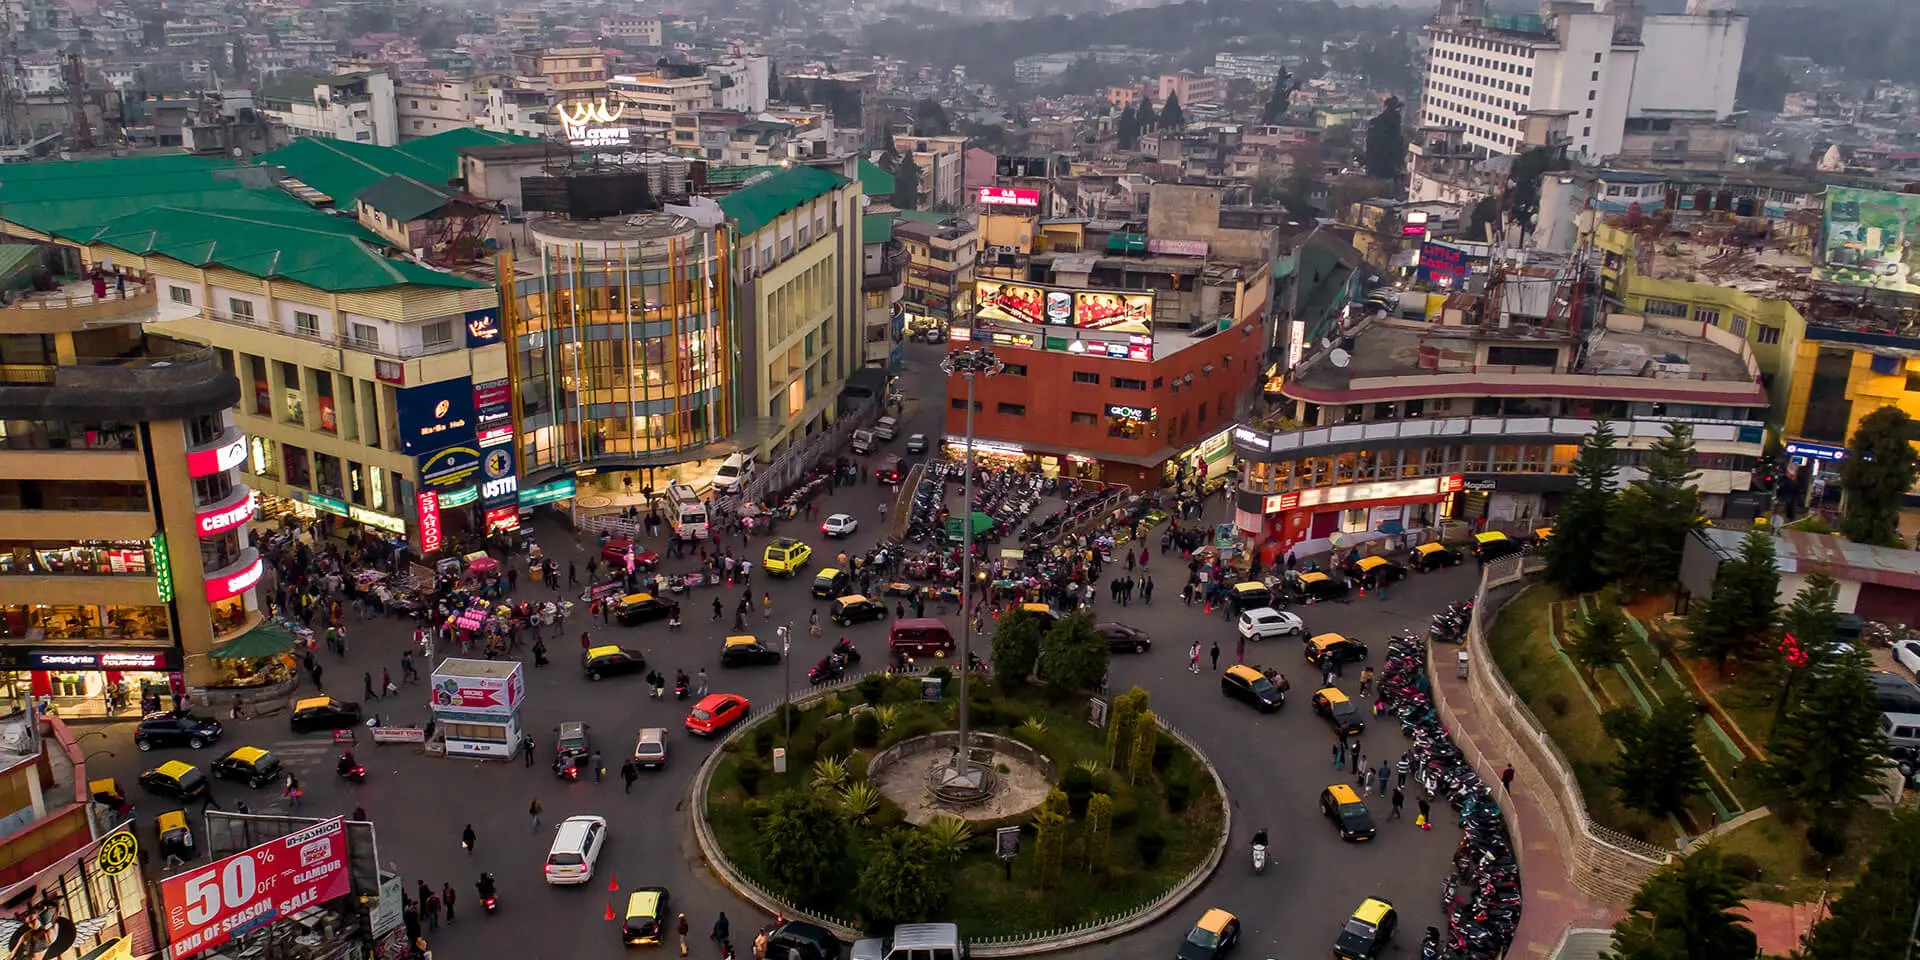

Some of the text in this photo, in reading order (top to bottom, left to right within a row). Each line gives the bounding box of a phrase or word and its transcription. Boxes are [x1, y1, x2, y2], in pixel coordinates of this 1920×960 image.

[41, 656, 95, 665] Samsonite
[257, 874, 278, 894] OFF
[293, 860, 341, 885] GLAMOUR
[171, 905, 186, 931] UPTO
[174, 933, 202, 956] END
[203, 923, 220, 941] OF
[221, 897, 273, 932] SEASON
[280, 886, 318, 915] SALE
